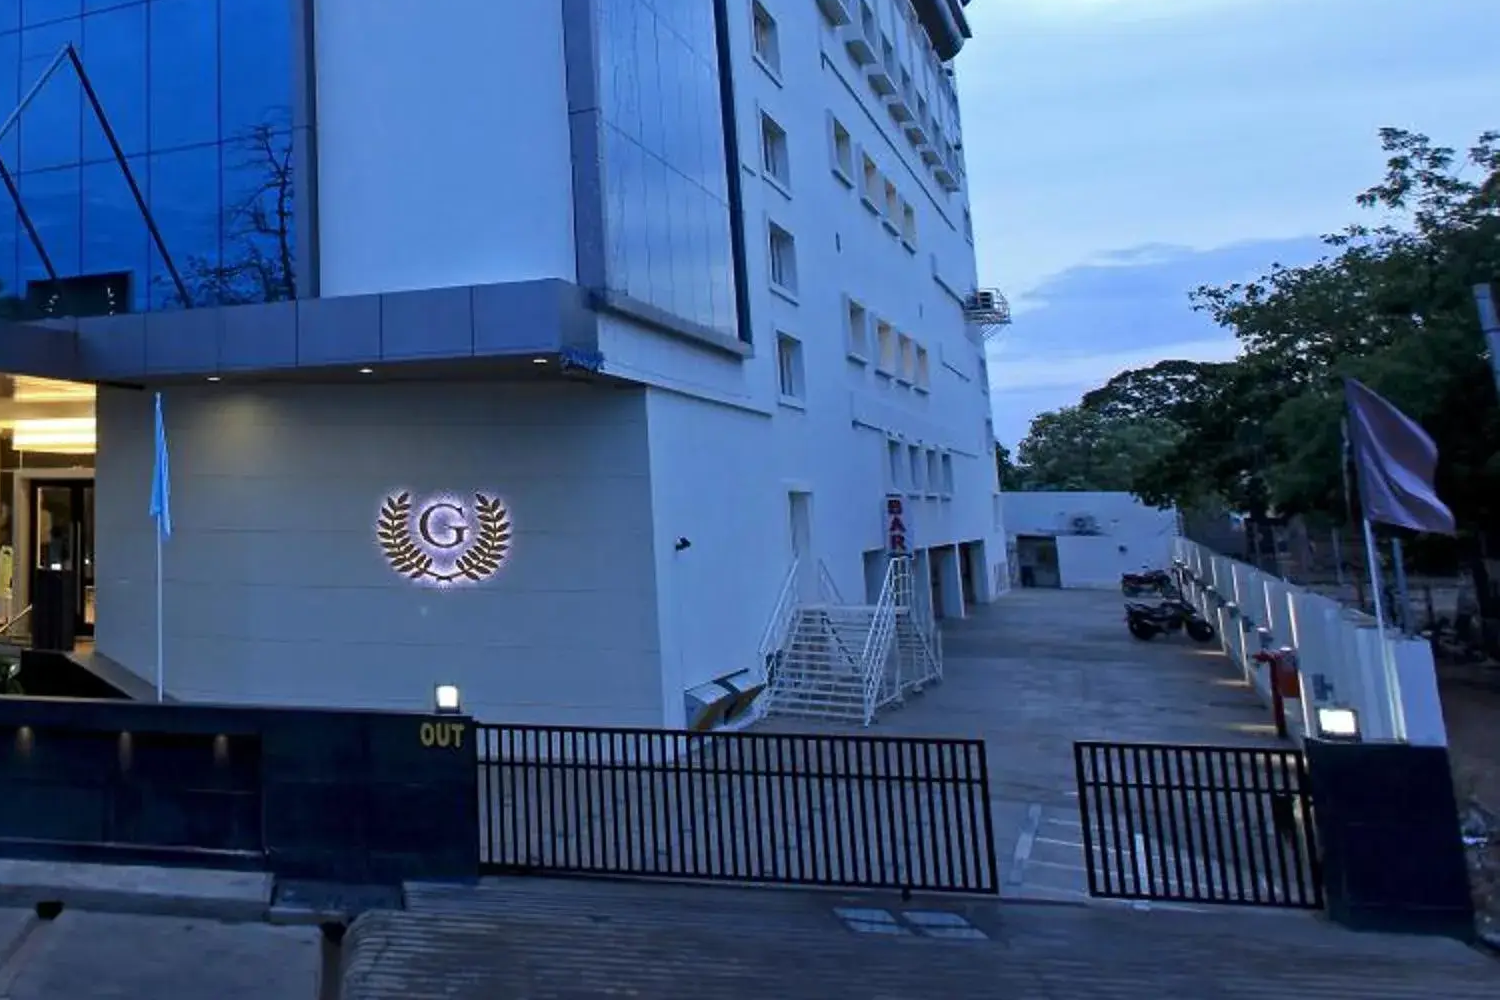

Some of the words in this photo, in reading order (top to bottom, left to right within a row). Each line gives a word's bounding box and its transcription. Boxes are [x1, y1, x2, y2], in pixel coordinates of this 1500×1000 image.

[419, 503, 470, 548] G
[887, 499, 907, 550] BAR
[420, 722, 465, 748] OUT
